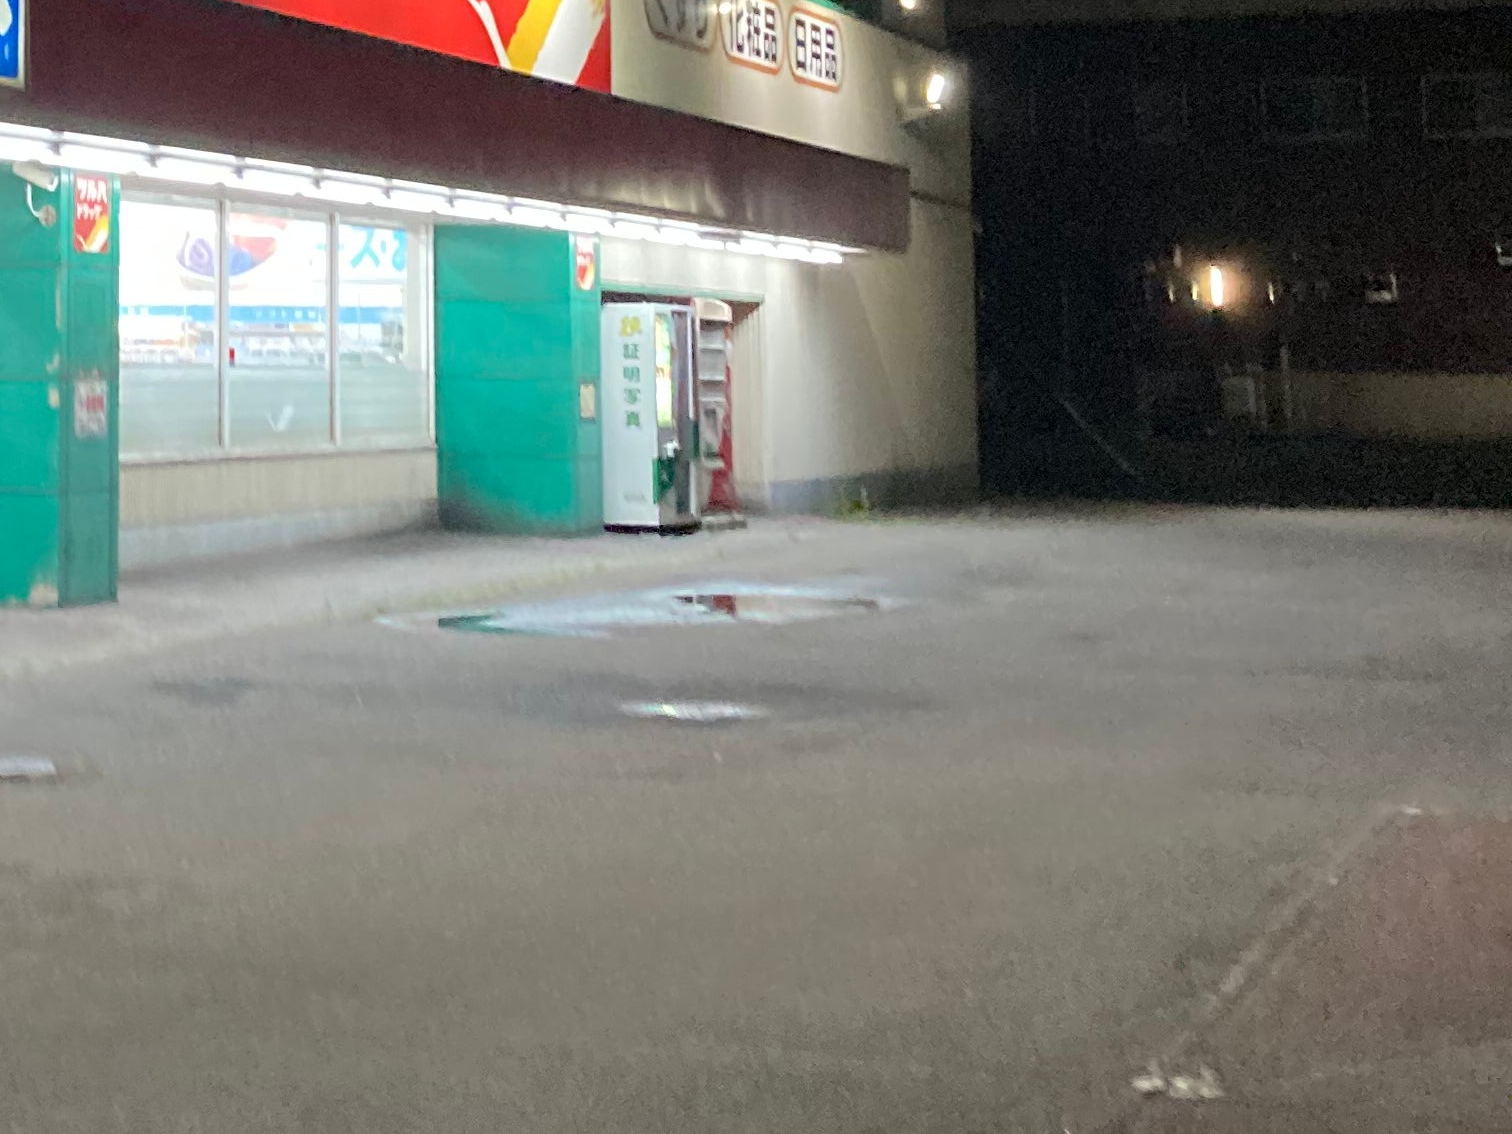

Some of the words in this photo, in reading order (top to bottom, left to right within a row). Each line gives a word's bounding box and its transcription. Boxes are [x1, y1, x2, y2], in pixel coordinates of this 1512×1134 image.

[795, 17, 837, 82] 日用品
[76, 177, 108, 204] ツルハ
